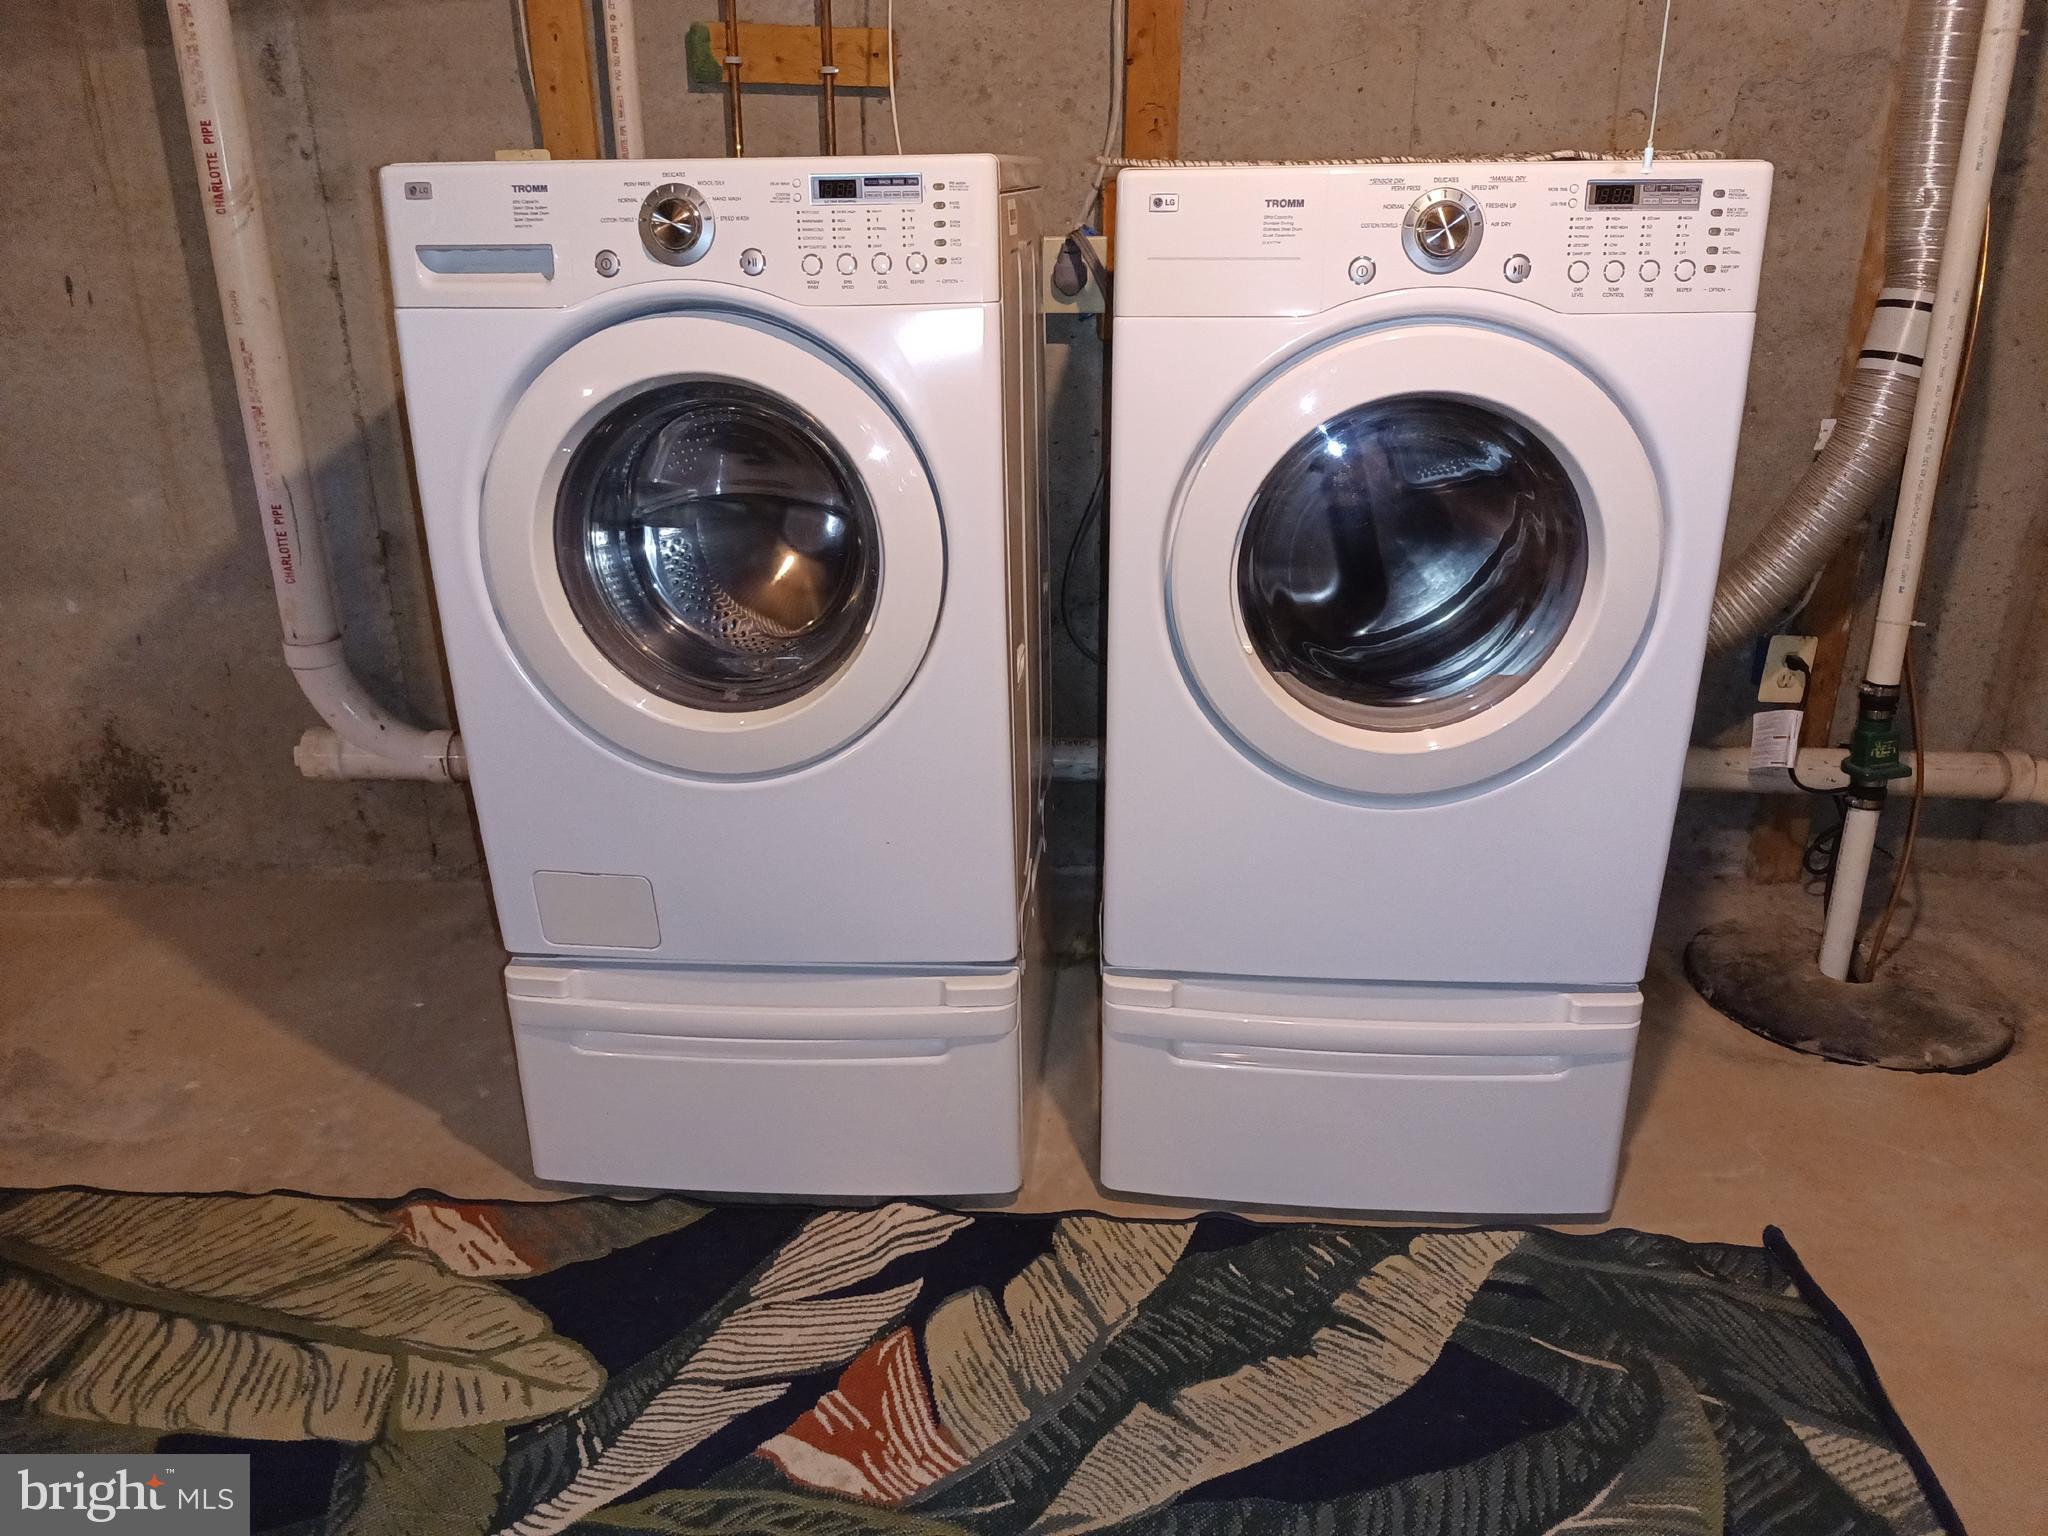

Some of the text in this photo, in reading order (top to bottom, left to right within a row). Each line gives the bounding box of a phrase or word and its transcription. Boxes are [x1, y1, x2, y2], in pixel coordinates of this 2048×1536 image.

[200, 120, 226, 215] CHARLOTTE PIPE
[512, 185, 548, 193] TROMM
[1265, 199, 1304, 208] TROMM
[271, 504, 296, 584] CHARLOTTE PIPE
